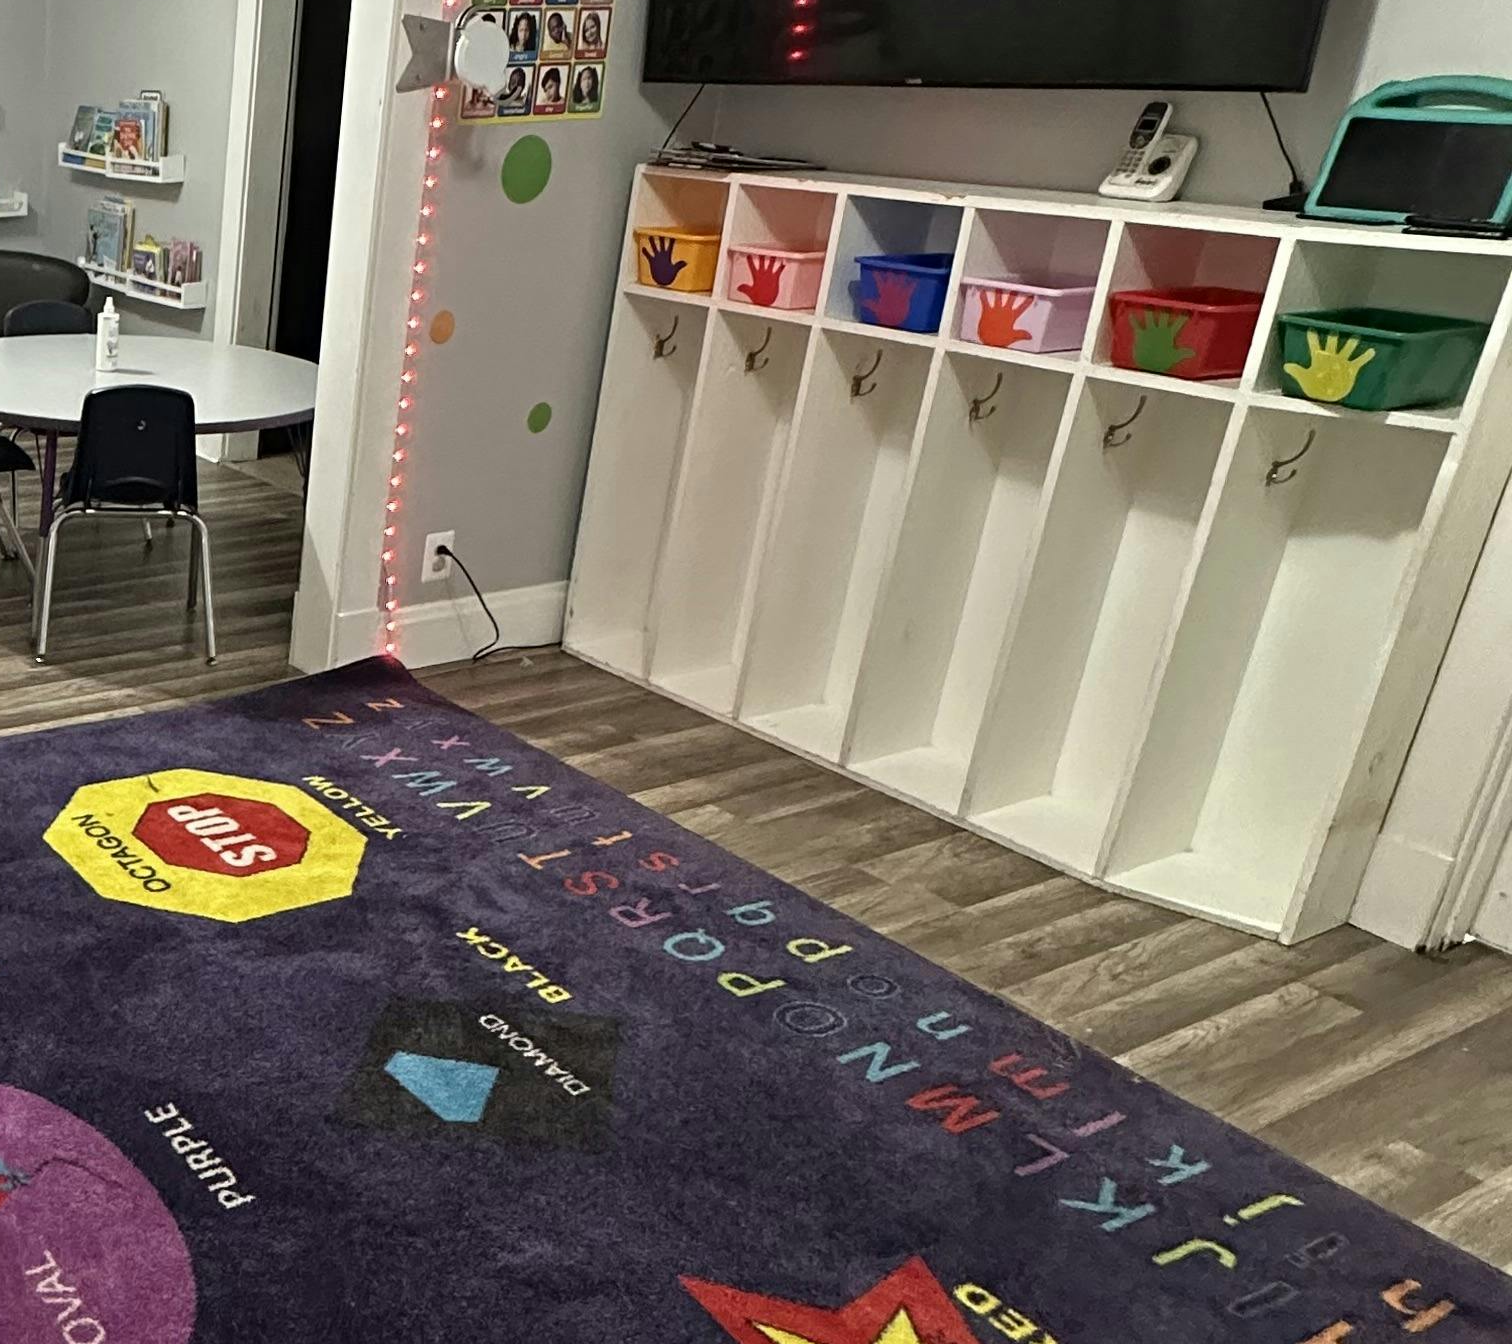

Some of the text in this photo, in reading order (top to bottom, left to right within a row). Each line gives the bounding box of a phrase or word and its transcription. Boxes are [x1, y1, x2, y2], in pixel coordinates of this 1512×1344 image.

[302, 711, 354, 732] Z
[360, 748, 418, 768] X
[302, 773, 403, 840] YELLOW
[437, 800, 492, 821] V
[167, 804, 278, 869] STOP
[591, 830, 633, 846] t
[72, 813, 171, 893] OCTAGON
[517, 848, 571, 870] T
[565, 871, 618, 895] S
[609, 898, 670, 928] R
[726, 901, 776, 926] q
[664, 929, 725, 961] Q
[786, 938, 853, 964] p
[456, 927, 574, 1004] BLACK
[717, 972, 786, 997] P
[917, 1009, 972, 1039] n
[478, 1013, 591, 1098] DIAMOND
[837, 1042, 920, 1083] N
[906, 1083, 1002, 1133] M
[143, 1101, 256, 1209] PURPLE
[1015, 1134, 1072, 1176] L
[1060, 1178, 1156, 1232] K
[1223, 1193, 1305, 1226] j
[1152, 1237, 1238, 1269] J
[1380, 1279, 1455, 1333] h
